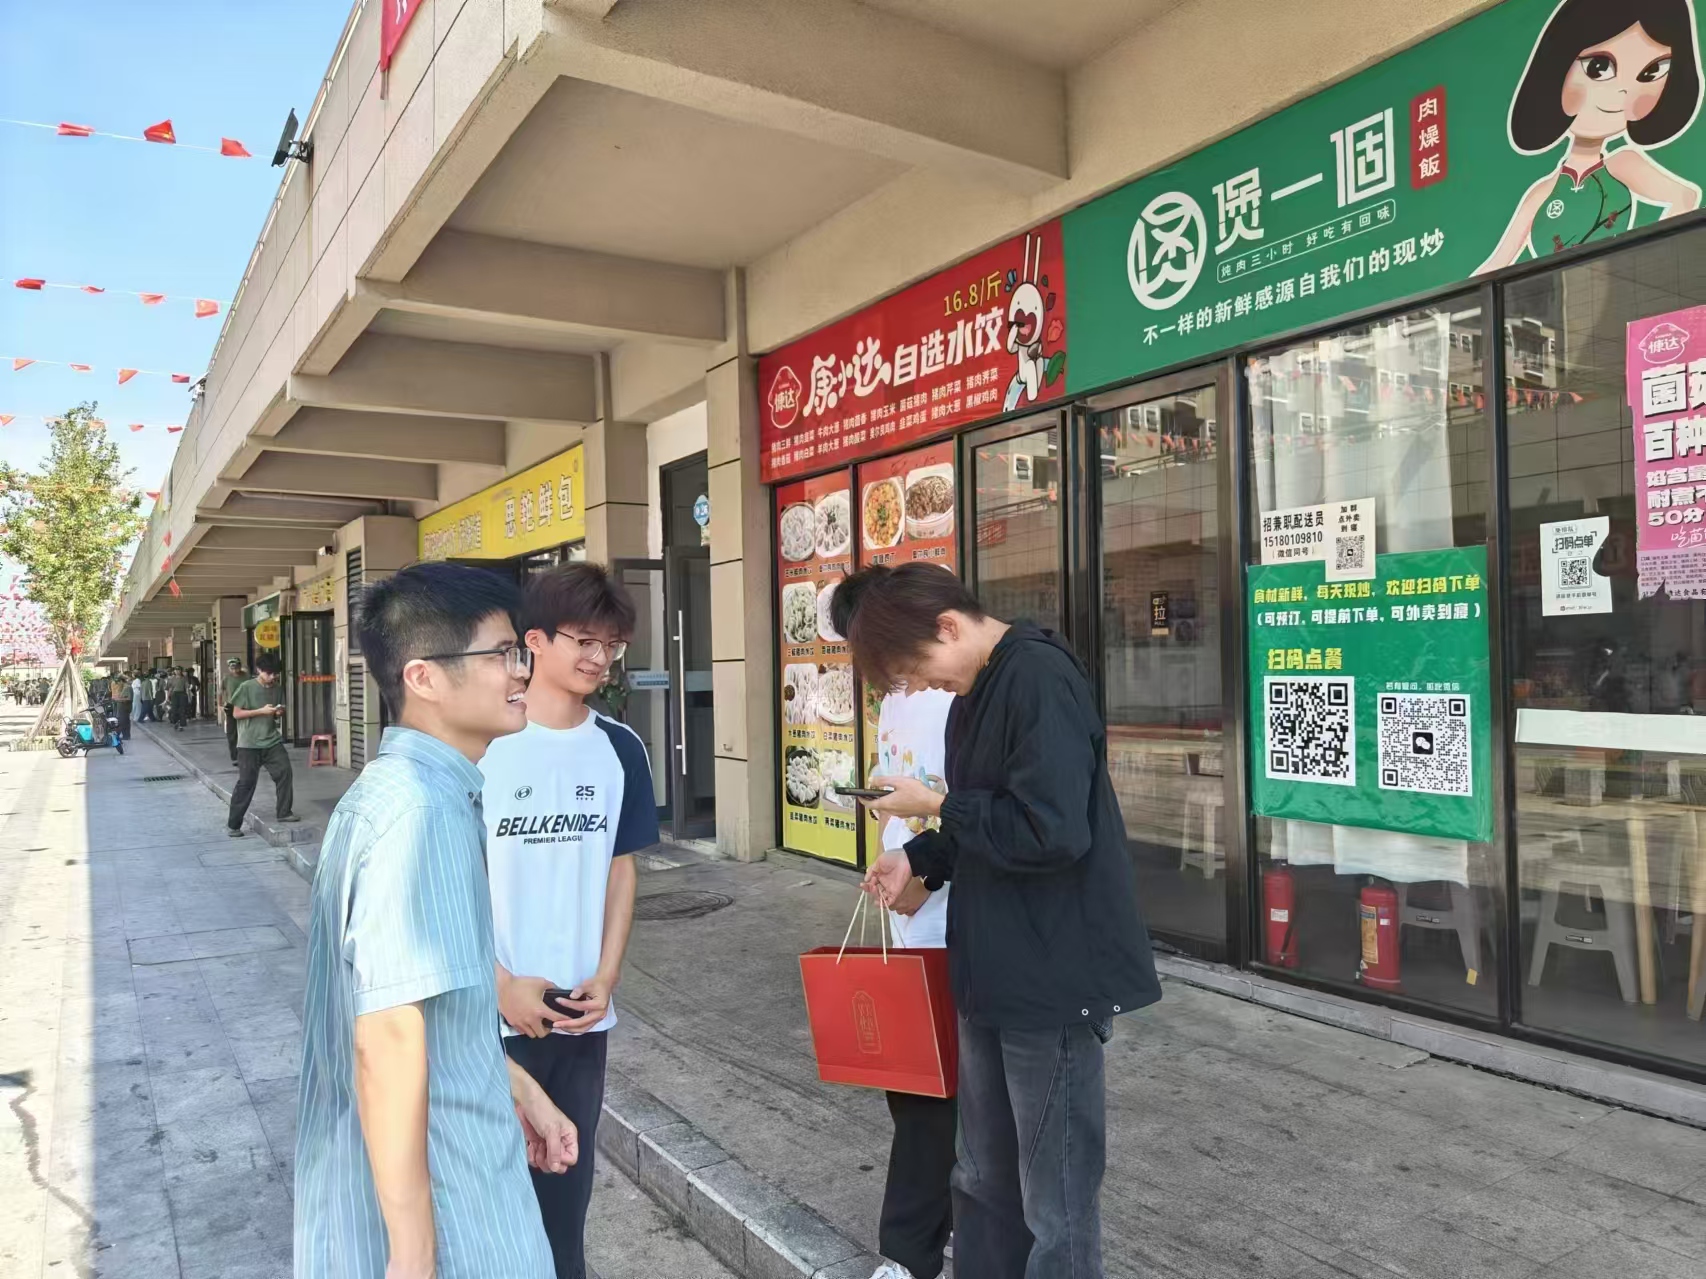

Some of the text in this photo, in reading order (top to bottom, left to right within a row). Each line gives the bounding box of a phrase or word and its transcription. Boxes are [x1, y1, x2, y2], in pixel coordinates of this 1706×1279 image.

[1417, 97, 1441, 180] 肉燥飯
[1220, 205, 1391, 279] 炖肉三小时 好吃有回味
[943, 270, 1002, 317] 16.8/斤
[1142, 228, 1446, 347] 不一样的新鲜感源自我们的现炒
[870, 403, 896, 423] 猪肉玉米
[931, 380, 962, 402] 猪肉芹菜
[931, 399, 961, 420] 猪肉大葱
[1263, 511, 1324, 532] 招兼职配送员
[1264, 531, 1323, 548] 15180109810
[1555, 534, 1594, 551] 扫码点单
[1671, 525, 1706, 547] 吃菌
[1153, 605, 1166, 621] 拉
[1267, 647, 1344, 670] 扫码点餐
[575, 785, 596, 797] 25
[523, 835, 583, 845] PREMIER LEAGU
